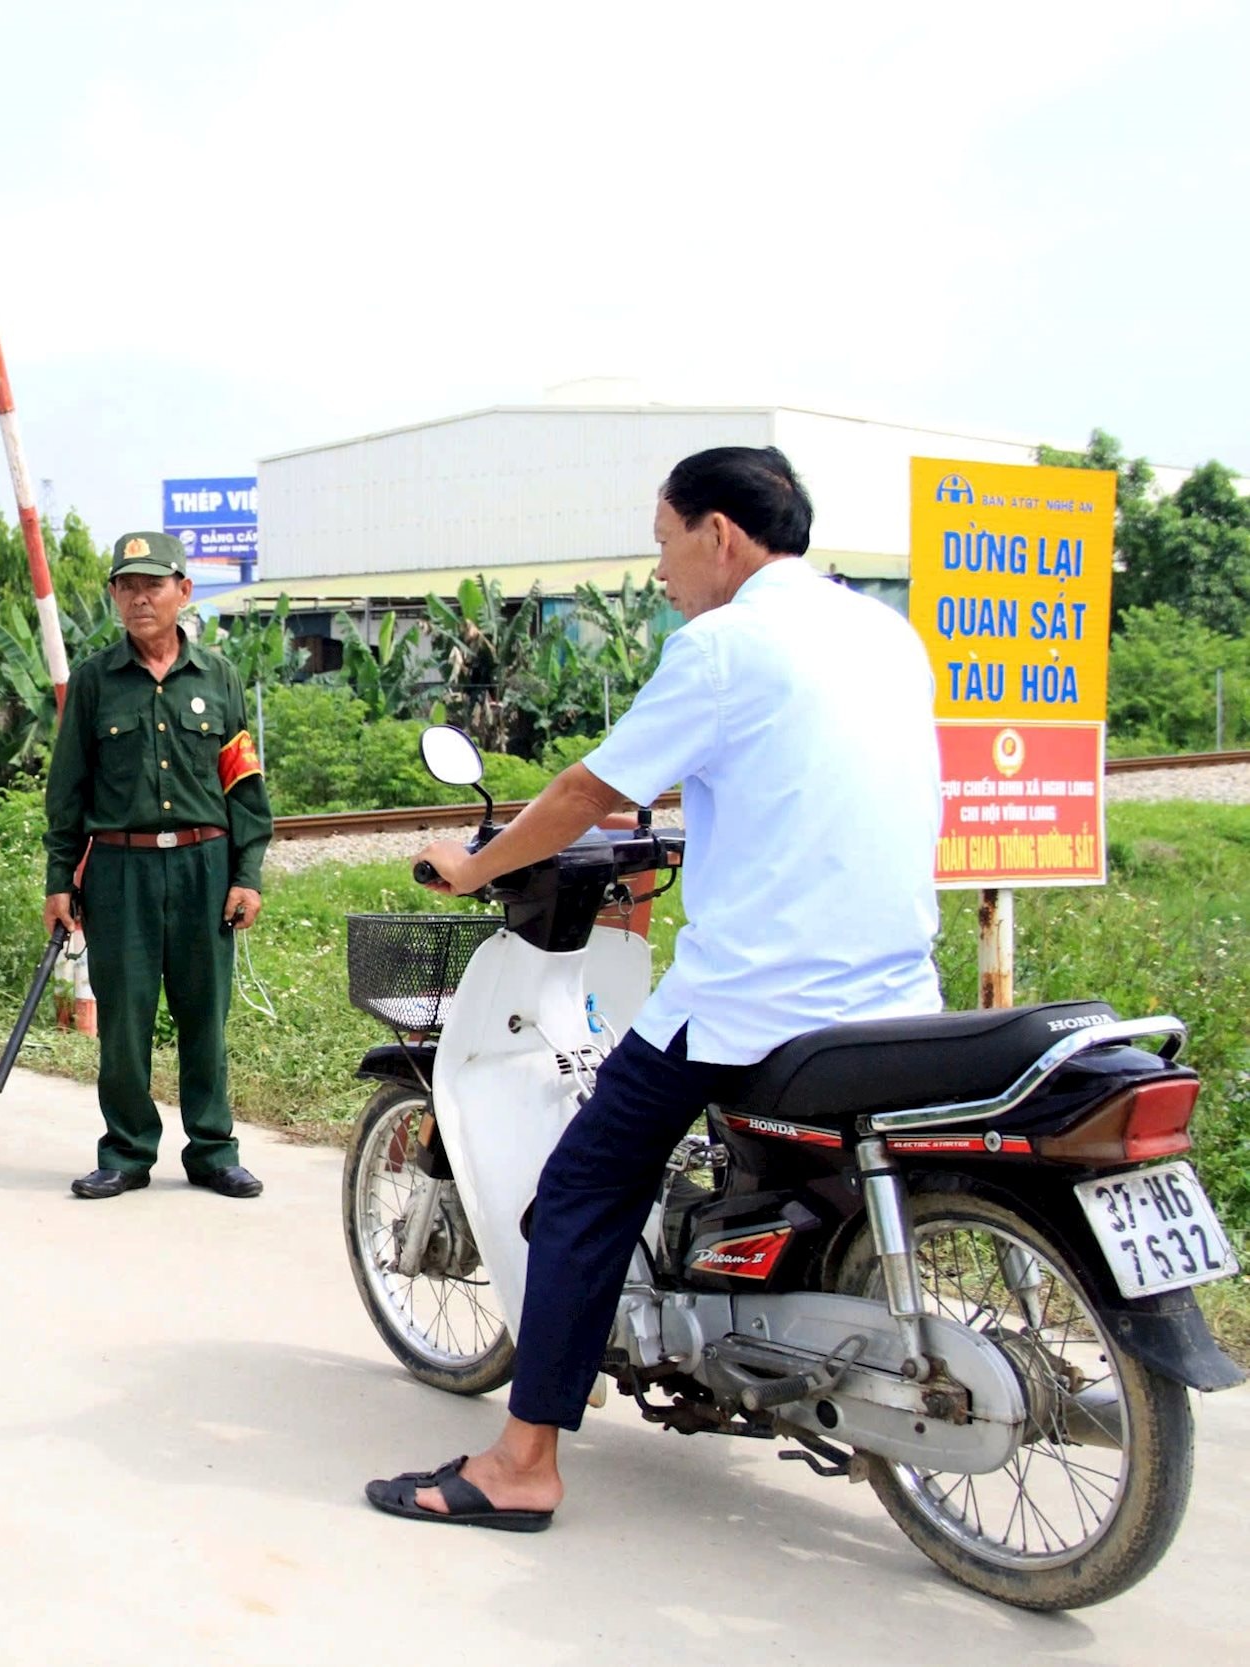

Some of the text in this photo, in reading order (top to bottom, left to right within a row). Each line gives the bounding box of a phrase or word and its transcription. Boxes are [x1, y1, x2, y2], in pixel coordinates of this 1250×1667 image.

[171, 487, 223, 513] THÉP
[982, 495, 1004, 507] BAN
[1046, 499, 1074, 514] NGHỆ
[1079, 502, 1093, 513] AN
[943, 521, 1082, 582] DỪNG LẠI
[937, 592, 1086, 640] QUAN SÁT
[1068, 781, 1094, 796] LONG
[1029, 805, 1056, 821] LONG
[969, 835, 996, 870] GIAO
[998, 827, 1036, 869] THÔNG
[1047, 1014, 1116, 1032] HONDA
[748, 1118, 798, 1137] HONDA
[1095, 1173, 1193, 1233] 37-H6
[694, 1248, 752, 1265] Dream
[1120, 1224, 1220, 1287] 7632
